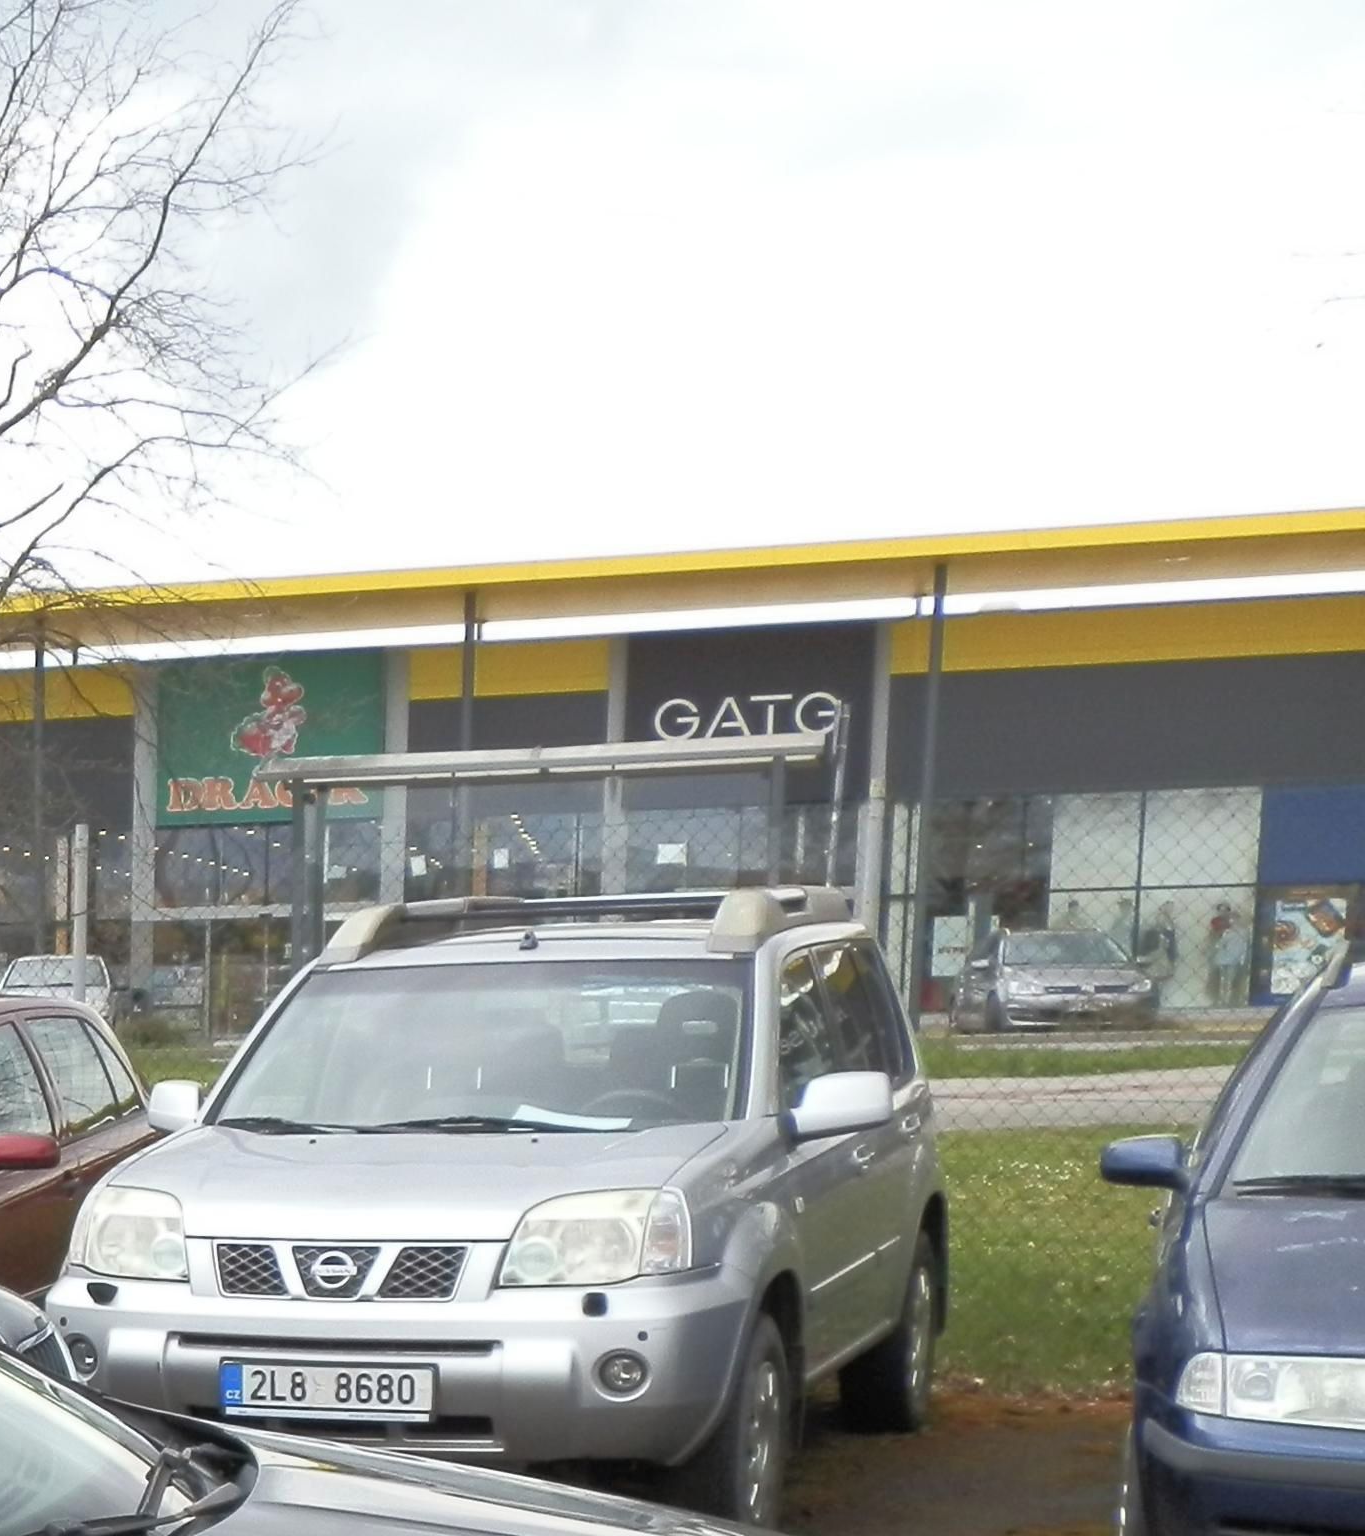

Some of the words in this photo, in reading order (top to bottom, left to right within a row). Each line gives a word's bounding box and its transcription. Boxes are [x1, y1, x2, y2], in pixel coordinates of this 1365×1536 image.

[225, 1390, 241, 1399] CZ
[250, 1370, 307, 1402] 2L8
[334, 1372, 416, 1405] 8680
